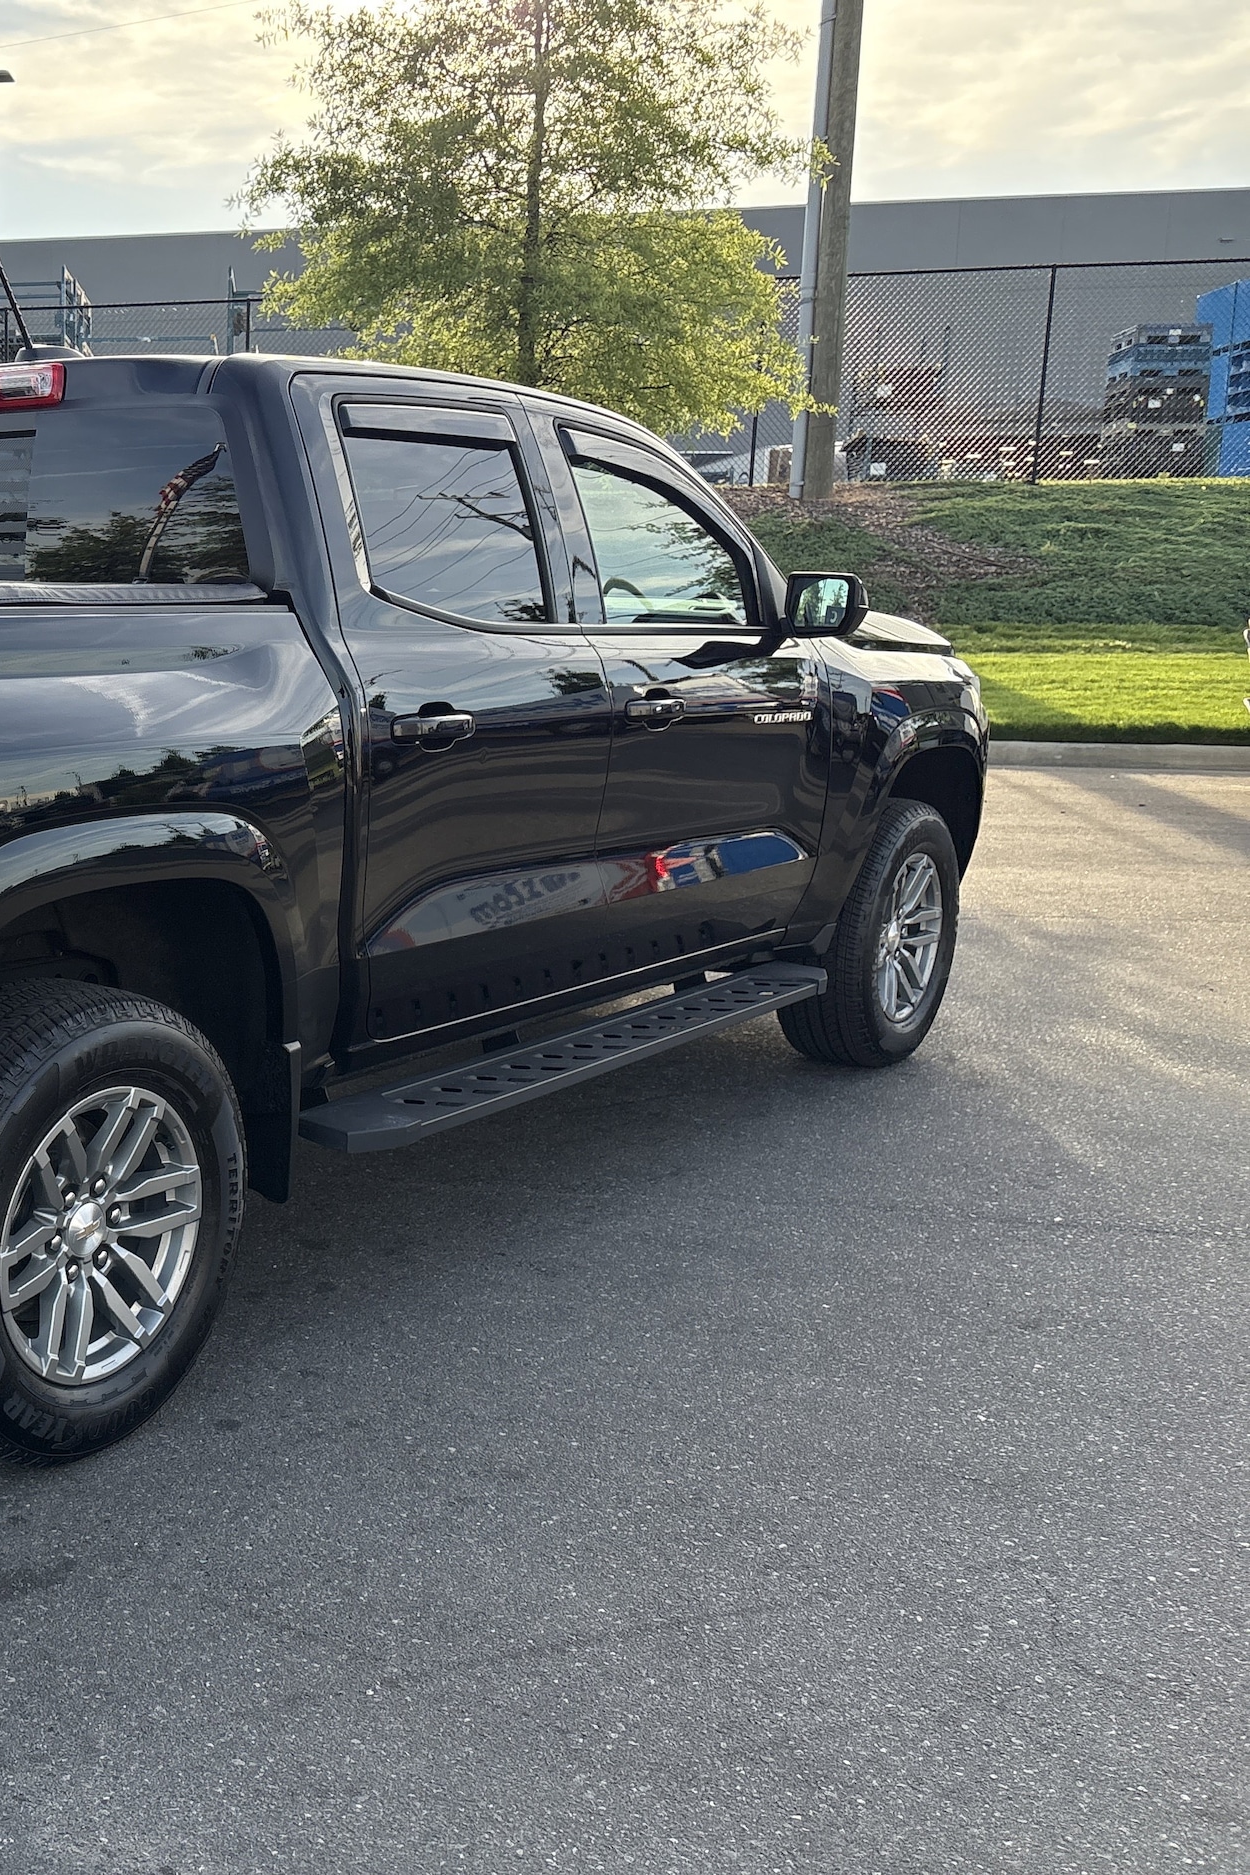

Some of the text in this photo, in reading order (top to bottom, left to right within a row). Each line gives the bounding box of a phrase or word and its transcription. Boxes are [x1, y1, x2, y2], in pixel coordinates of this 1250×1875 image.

[754, 711, 813, 724] COLORADO
[74, 1036, 213, 1097] WRANGLER
[215, 1152, 240, 1289] TERRITORY
